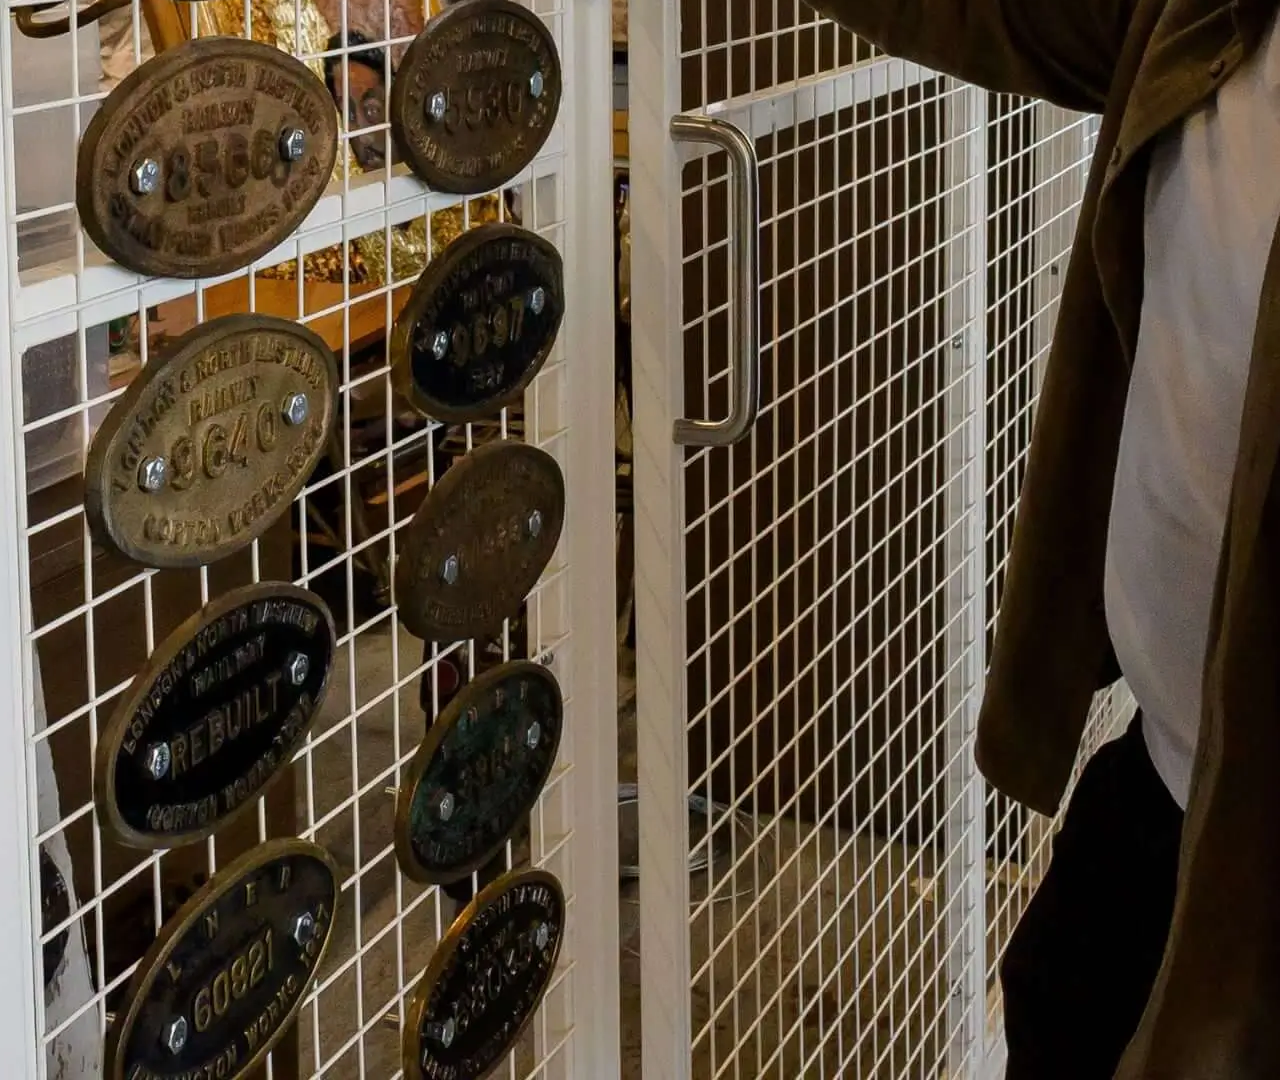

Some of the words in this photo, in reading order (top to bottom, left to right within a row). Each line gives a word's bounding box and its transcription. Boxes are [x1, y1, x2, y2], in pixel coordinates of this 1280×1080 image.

[122, 659, 184, 756] LONDON
[196, 607, 250, 661] NORTH
[169, 671, 283, 782] REBUILT
